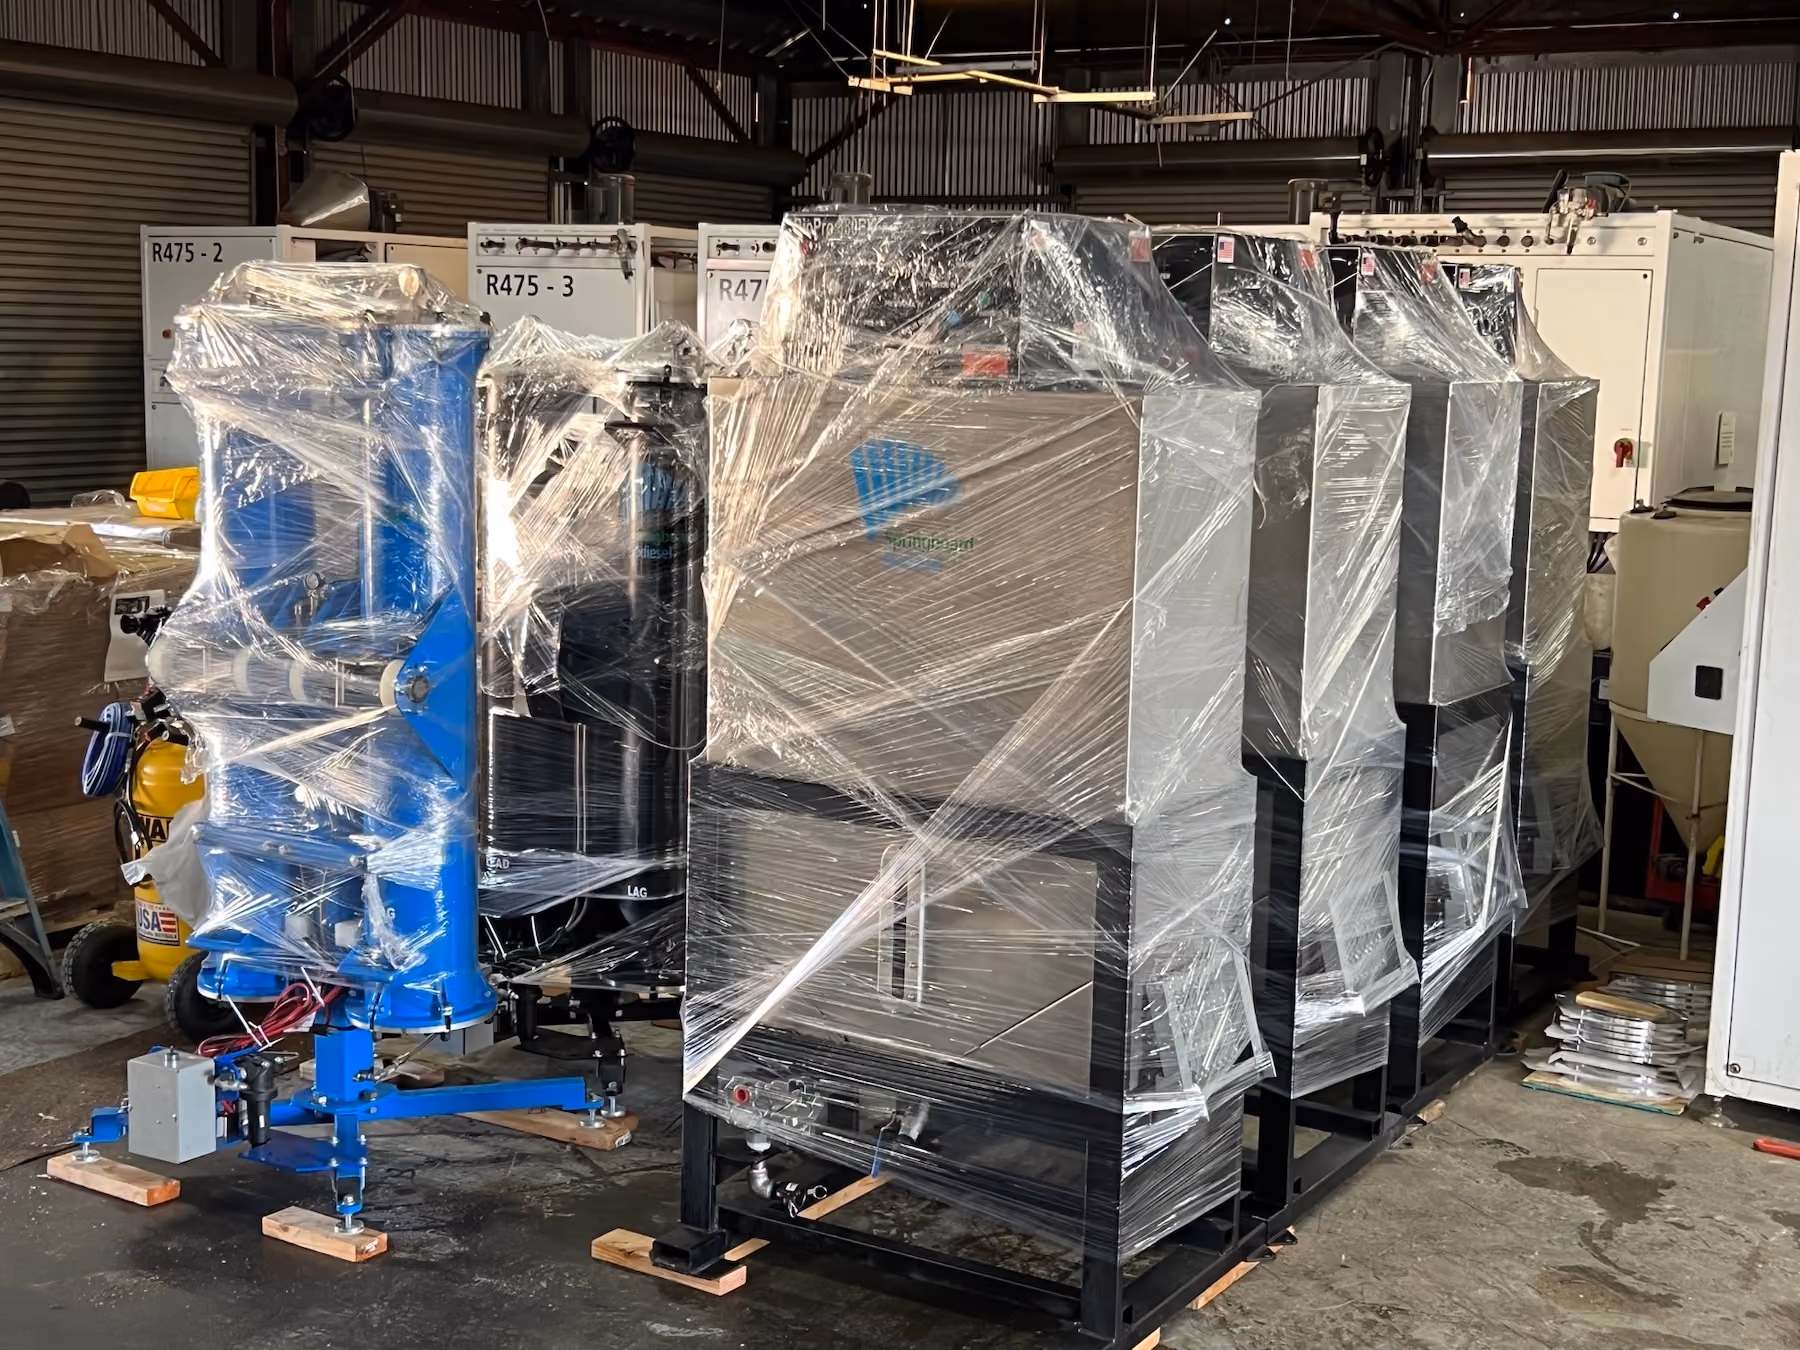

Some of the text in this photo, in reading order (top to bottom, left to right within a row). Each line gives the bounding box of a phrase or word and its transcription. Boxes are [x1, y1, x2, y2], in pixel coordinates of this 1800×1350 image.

[152, 242, 195, 263] R475
[213, 242, 223, 263] 2
[486, 274, 539, 296] R475
[562, 275, 574, 297] 3
[719, 278, 769, 302] R47
[627, 885, 648, 898] LAG
[137, 907, 162, 932] USA
